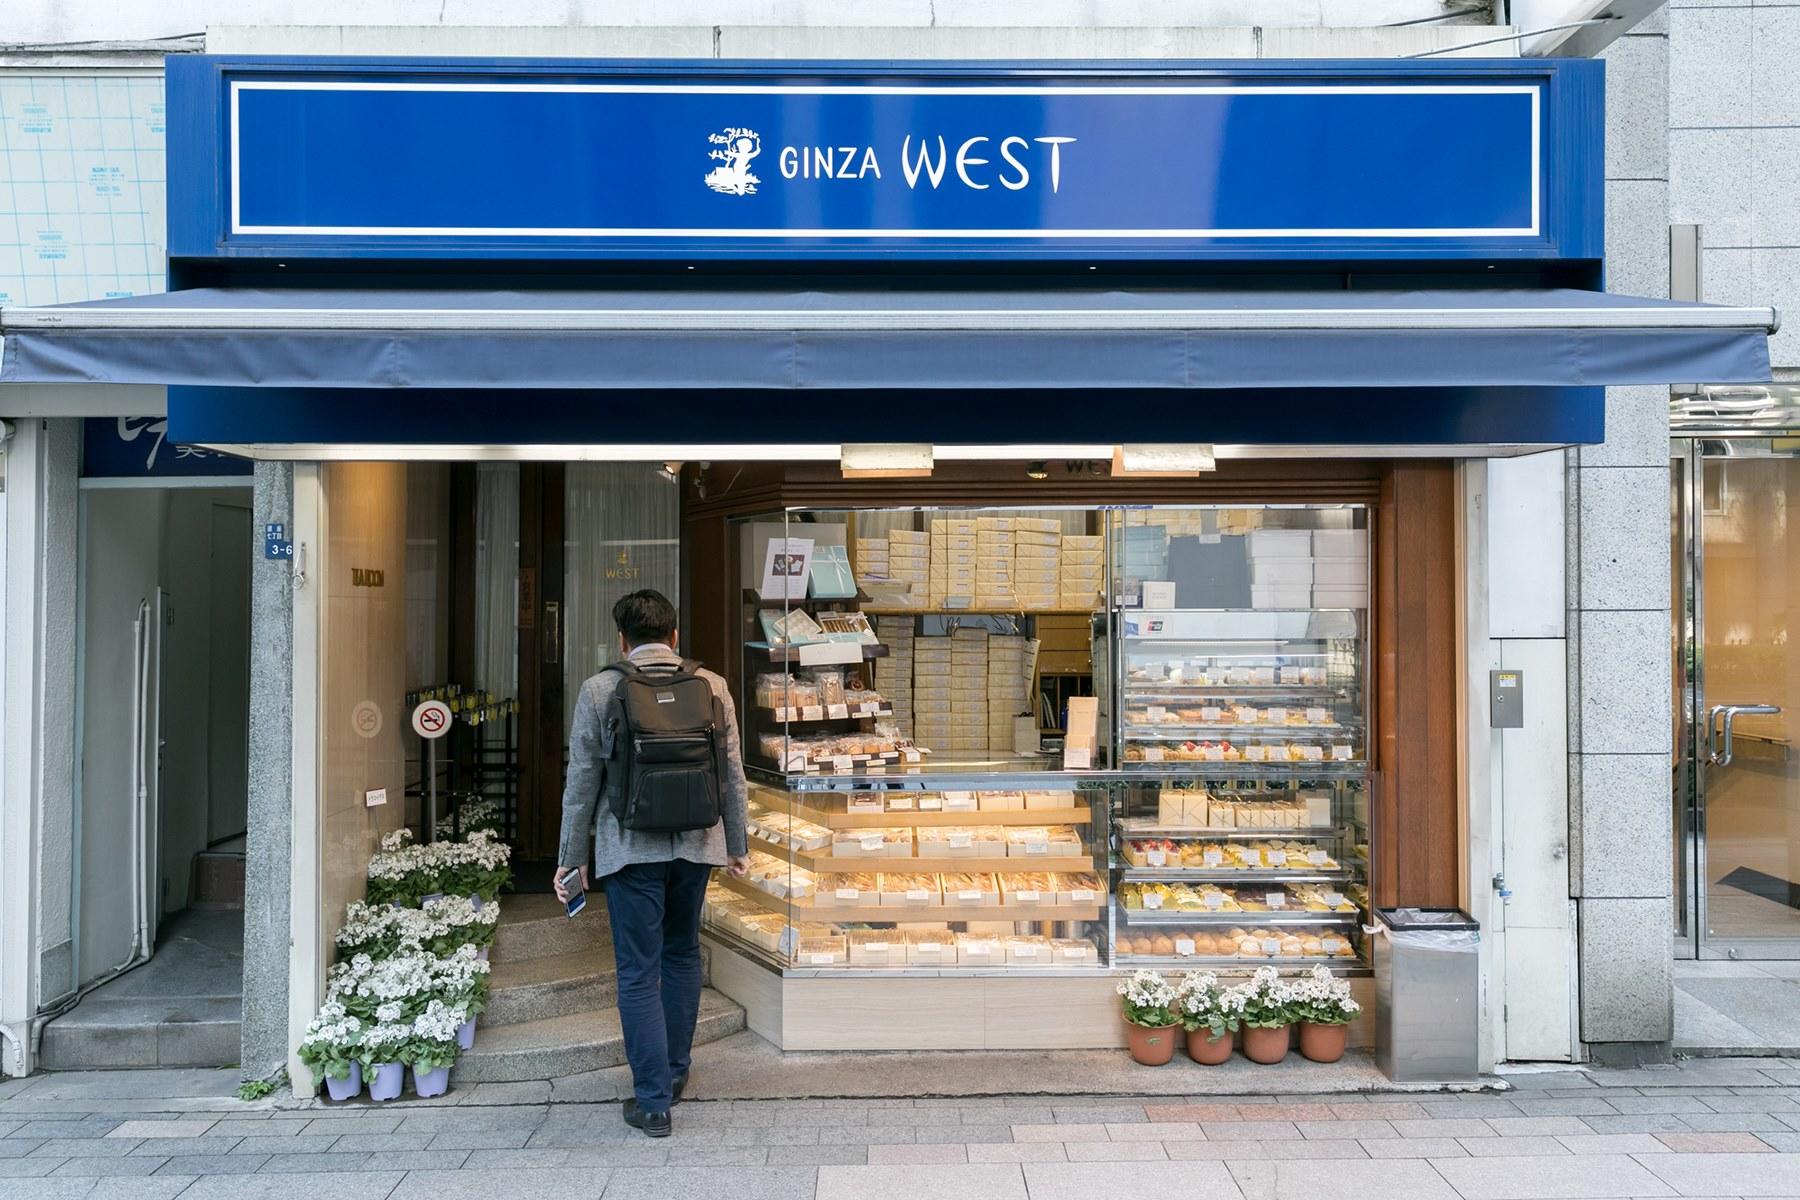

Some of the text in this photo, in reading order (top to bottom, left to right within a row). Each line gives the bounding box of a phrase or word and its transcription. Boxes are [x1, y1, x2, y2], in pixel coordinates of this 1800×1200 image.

[780, 134, 1078, 194] GINZA WEST
[272, 544, 292, 555] 3-6
[606, 567, 640, 579] WEST
